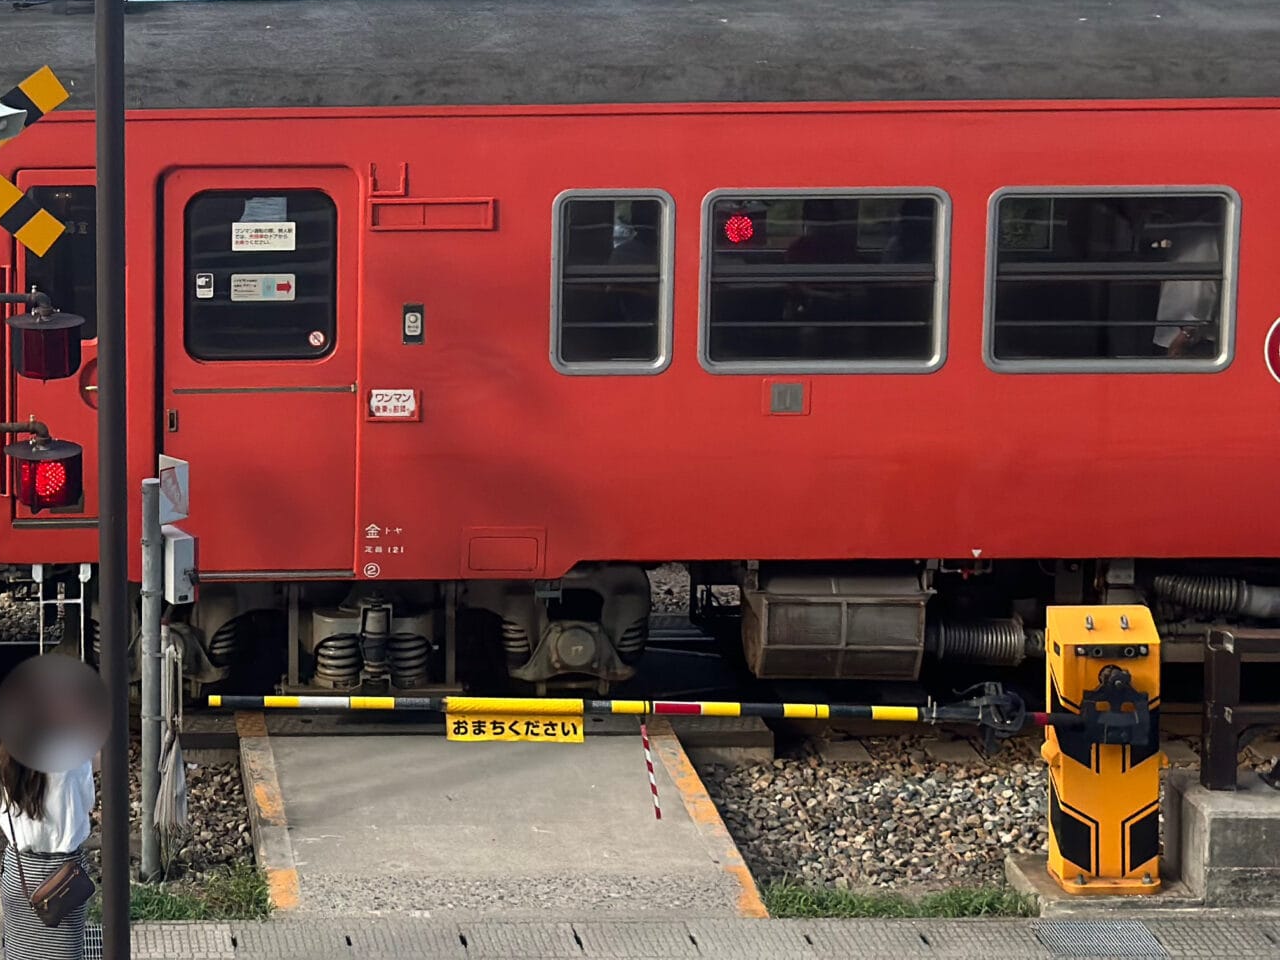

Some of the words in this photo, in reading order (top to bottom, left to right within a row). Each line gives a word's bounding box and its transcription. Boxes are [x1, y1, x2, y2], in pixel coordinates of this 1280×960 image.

[375, 393, 411, 403] ワンマン
[453, 720, 577, 736] おまちください
